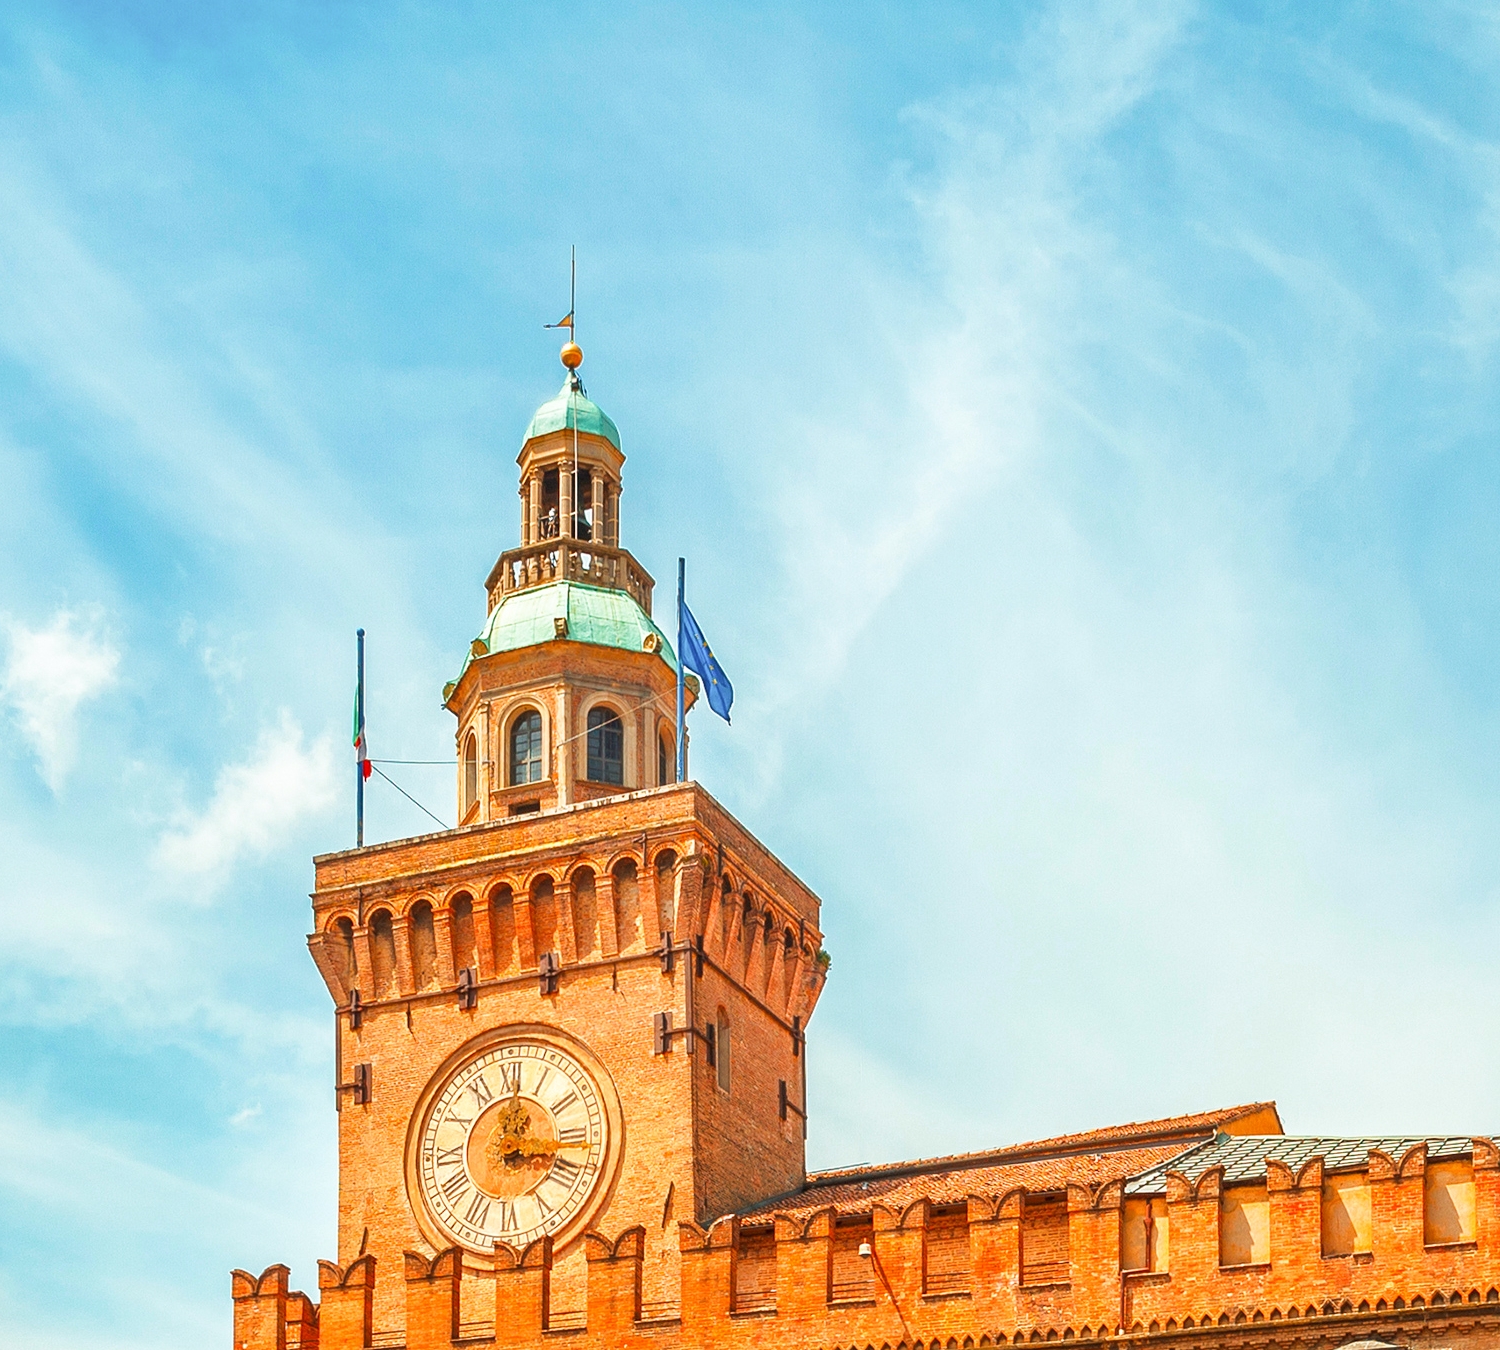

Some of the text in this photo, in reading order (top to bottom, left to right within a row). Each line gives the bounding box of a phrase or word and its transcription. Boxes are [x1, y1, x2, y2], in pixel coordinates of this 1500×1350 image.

[466, 1073, 495, 1110] XI
[499, 1061, 523, 1094] XII
[531, 1066, 551, 1098] I
[550, 1089, 579, 1116] II
[444, 1107, 473, 1133] X
[437, 1143, 465, 1168] IX
[441, 1169, 471, 1210] VIII
[534, 1190, 554, 1219] V
[463, 1191, 491, 1229] VII
[498, 1200, 520, 1232] VI
